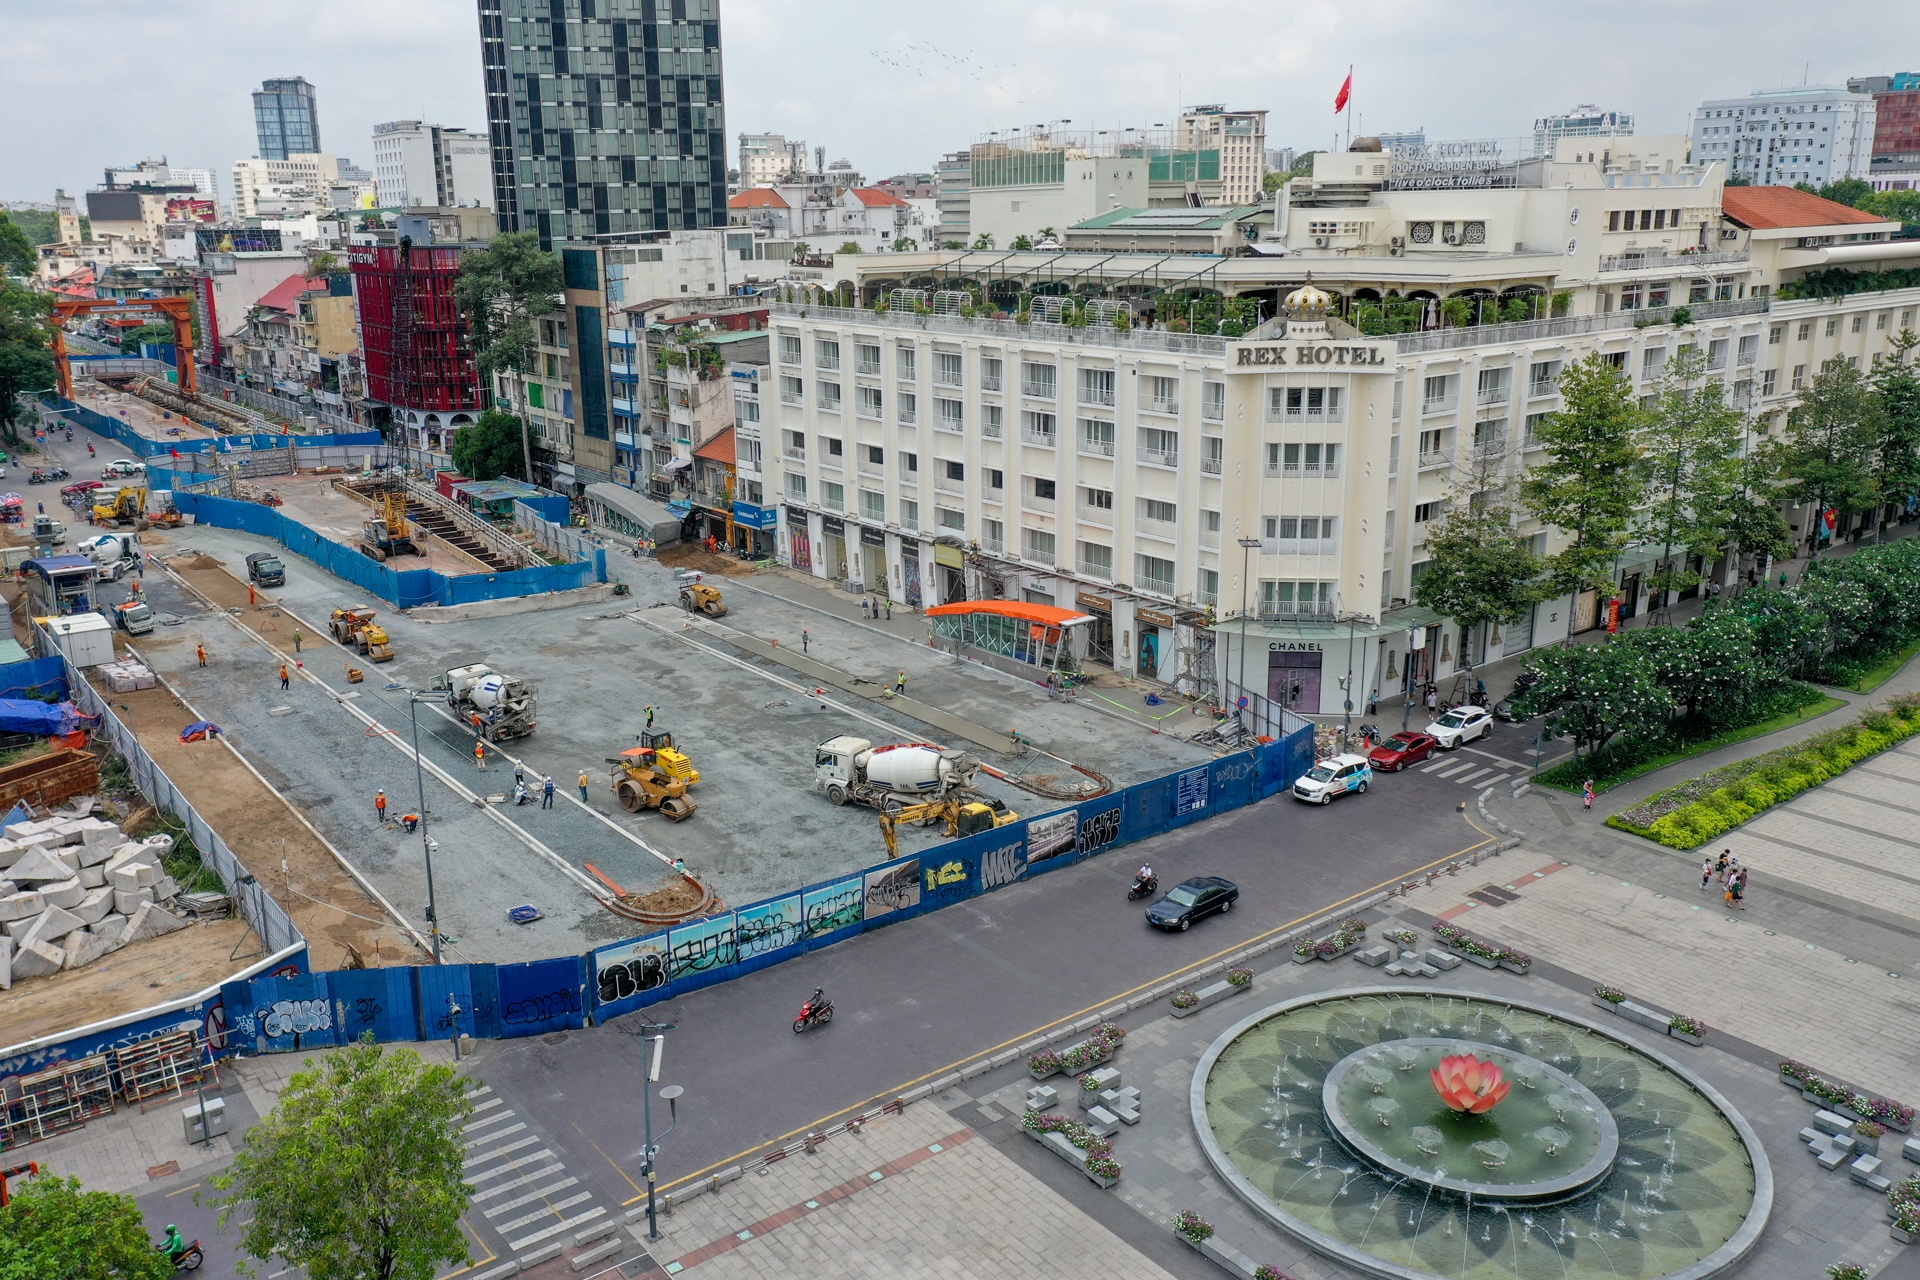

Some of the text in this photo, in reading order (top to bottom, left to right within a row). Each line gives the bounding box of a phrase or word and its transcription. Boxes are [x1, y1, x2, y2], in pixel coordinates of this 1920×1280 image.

[1391, 141, 1502, 160] REX HOTEL
[1390, 160, 1498, 173] ROOFTOP GARDEN BAR
[1237, 346, 1385, 366] REX HOTEL
[1269, 642, 1323, 651] CHANEL
